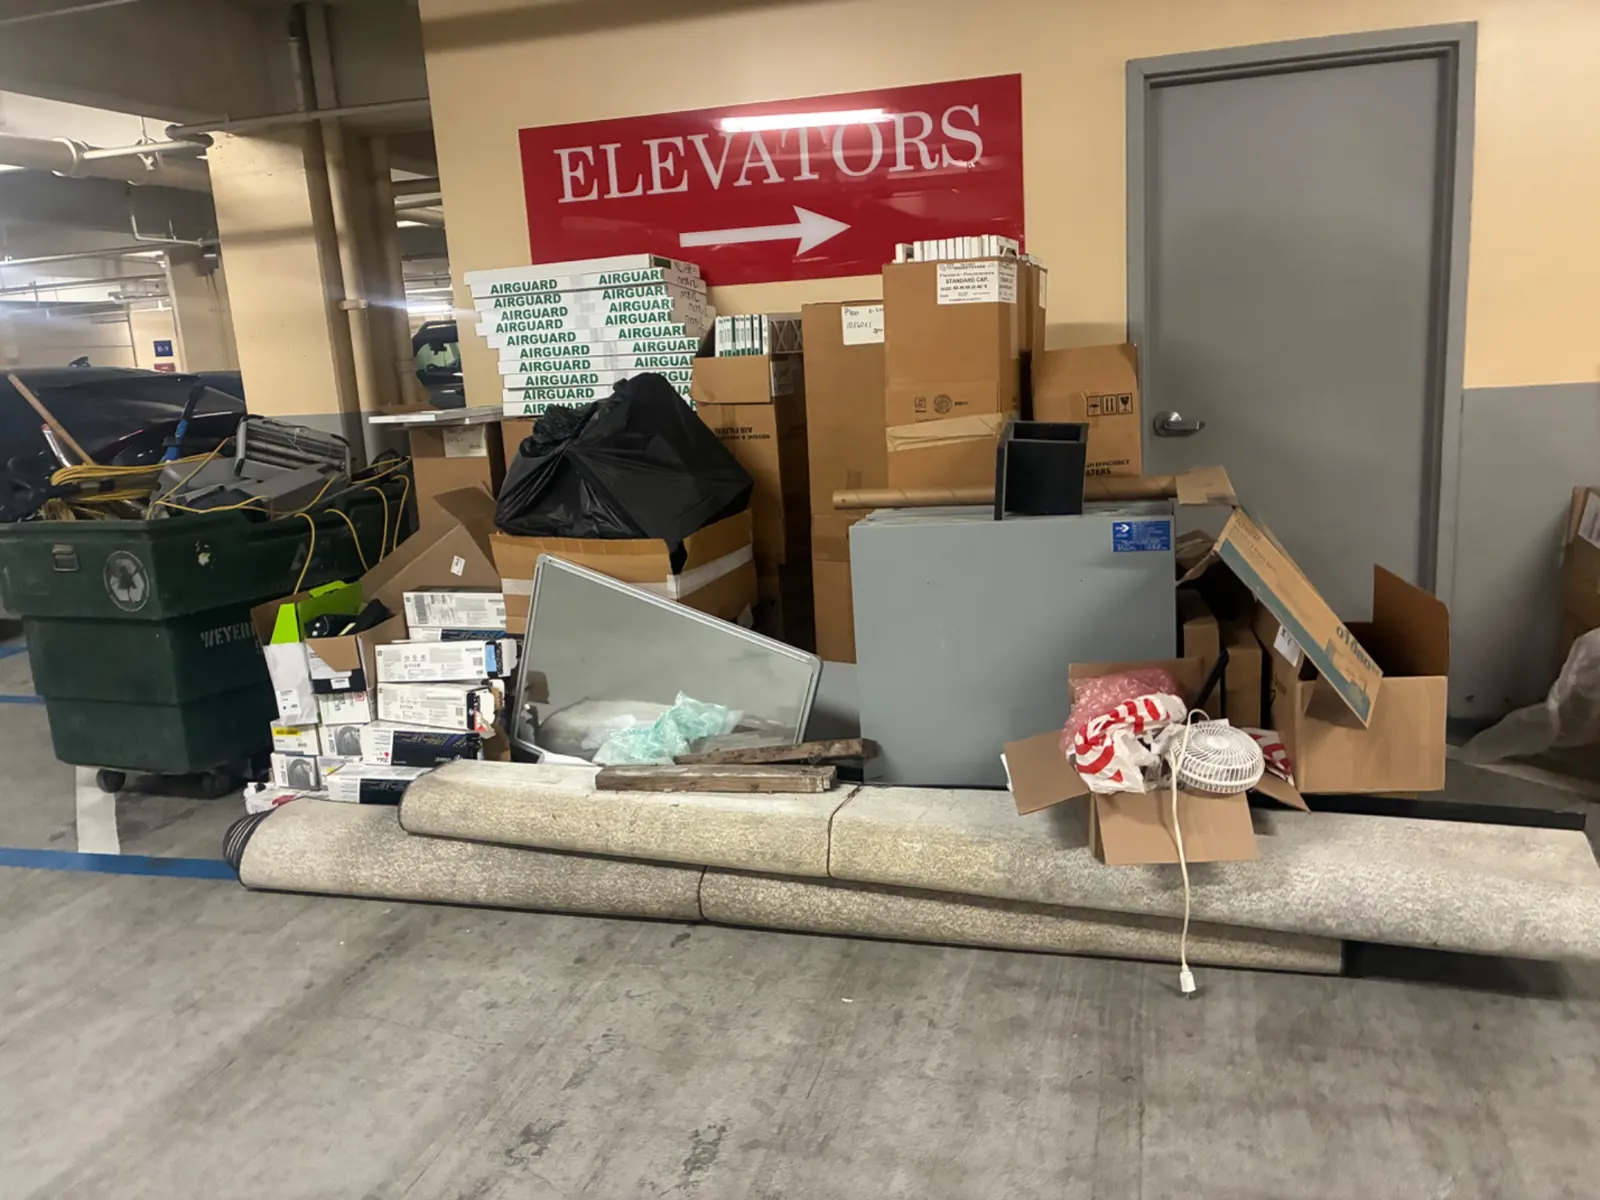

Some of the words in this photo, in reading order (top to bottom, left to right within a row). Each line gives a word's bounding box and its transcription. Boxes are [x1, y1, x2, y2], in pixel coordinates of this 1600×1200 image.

[553, 103, 984, 204] ELEVATORS
[490, 279, 558, 294] AIRGUARD
[493, 292, 562, 309] AIRGUARD
[501, 306, 569, 321] AIRGUARD
[496, 318, 564, 333] AIRGUARD
[507, 331, 577, 346] AIRGUARD
[520, 344, 591, 358] AIRGUARD
[519, 359, 591, 372] AIRGUARD
[634, 355, 694, 368] AIRGUA
[525, 373, 599, 386] AIRGUARD
[523, 388, 595, 400] AIRGUARD
